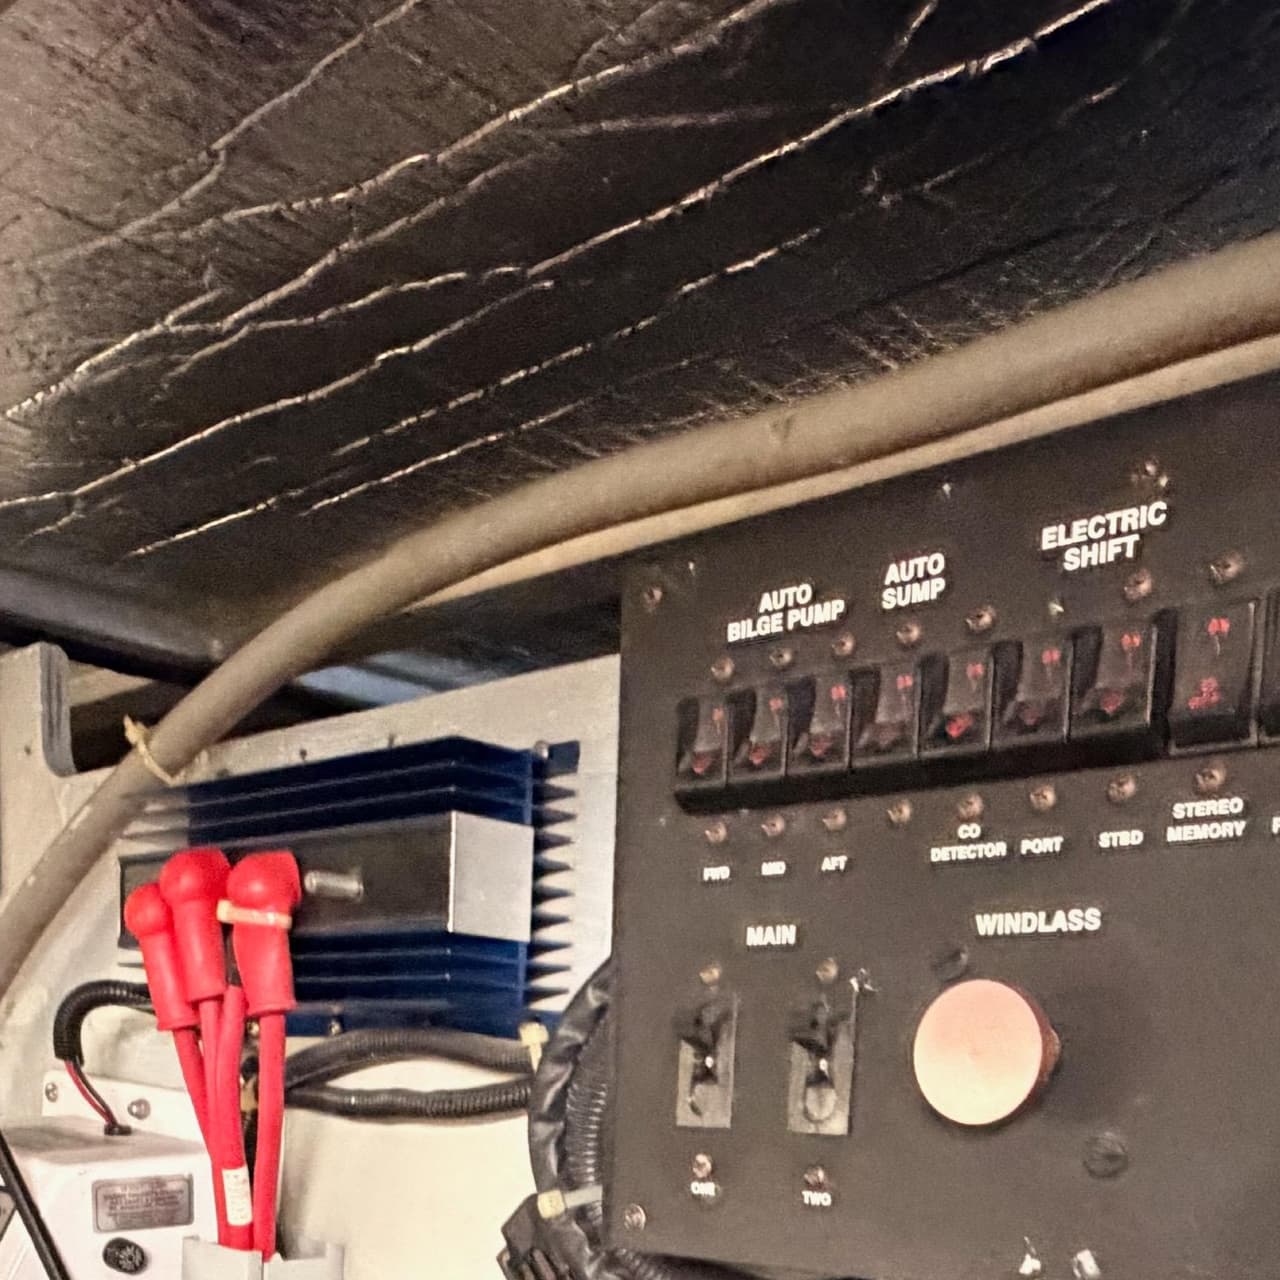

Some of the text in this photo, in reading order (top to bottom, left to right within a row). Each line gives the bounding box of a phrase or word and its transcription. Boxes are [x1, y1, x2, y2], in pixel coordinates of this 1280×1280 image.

[1042, 501, 1168, 551] ELECTRIC
[1063, 534, 1140, 571] SHIFT
[885, 553, 944, 585] AUTO
[759, 584, 813, 614] AUTO
[882, 578, 945, 609] SUMP
[728, 599, 845, 642] BILGE PUMP
[1173, 797, 1243, 819] STEREO
[958, 823, 981, 839] CO
[1099, 830, 1143, 847] STBD
[1167, 821, 1246, 842] MEMORY
[931, 841, 1007, 862] DETECTOR
[1021, 836, 1063, 854] PORT
[821, 855, 847, 871] AFT
[976, 907, 1101, 935] WINDLASS
[747, 925, 796, 946] MAIN
[691, 1181, 716, 1197] ONE
[802, 1191, 831, 1206] TWO
